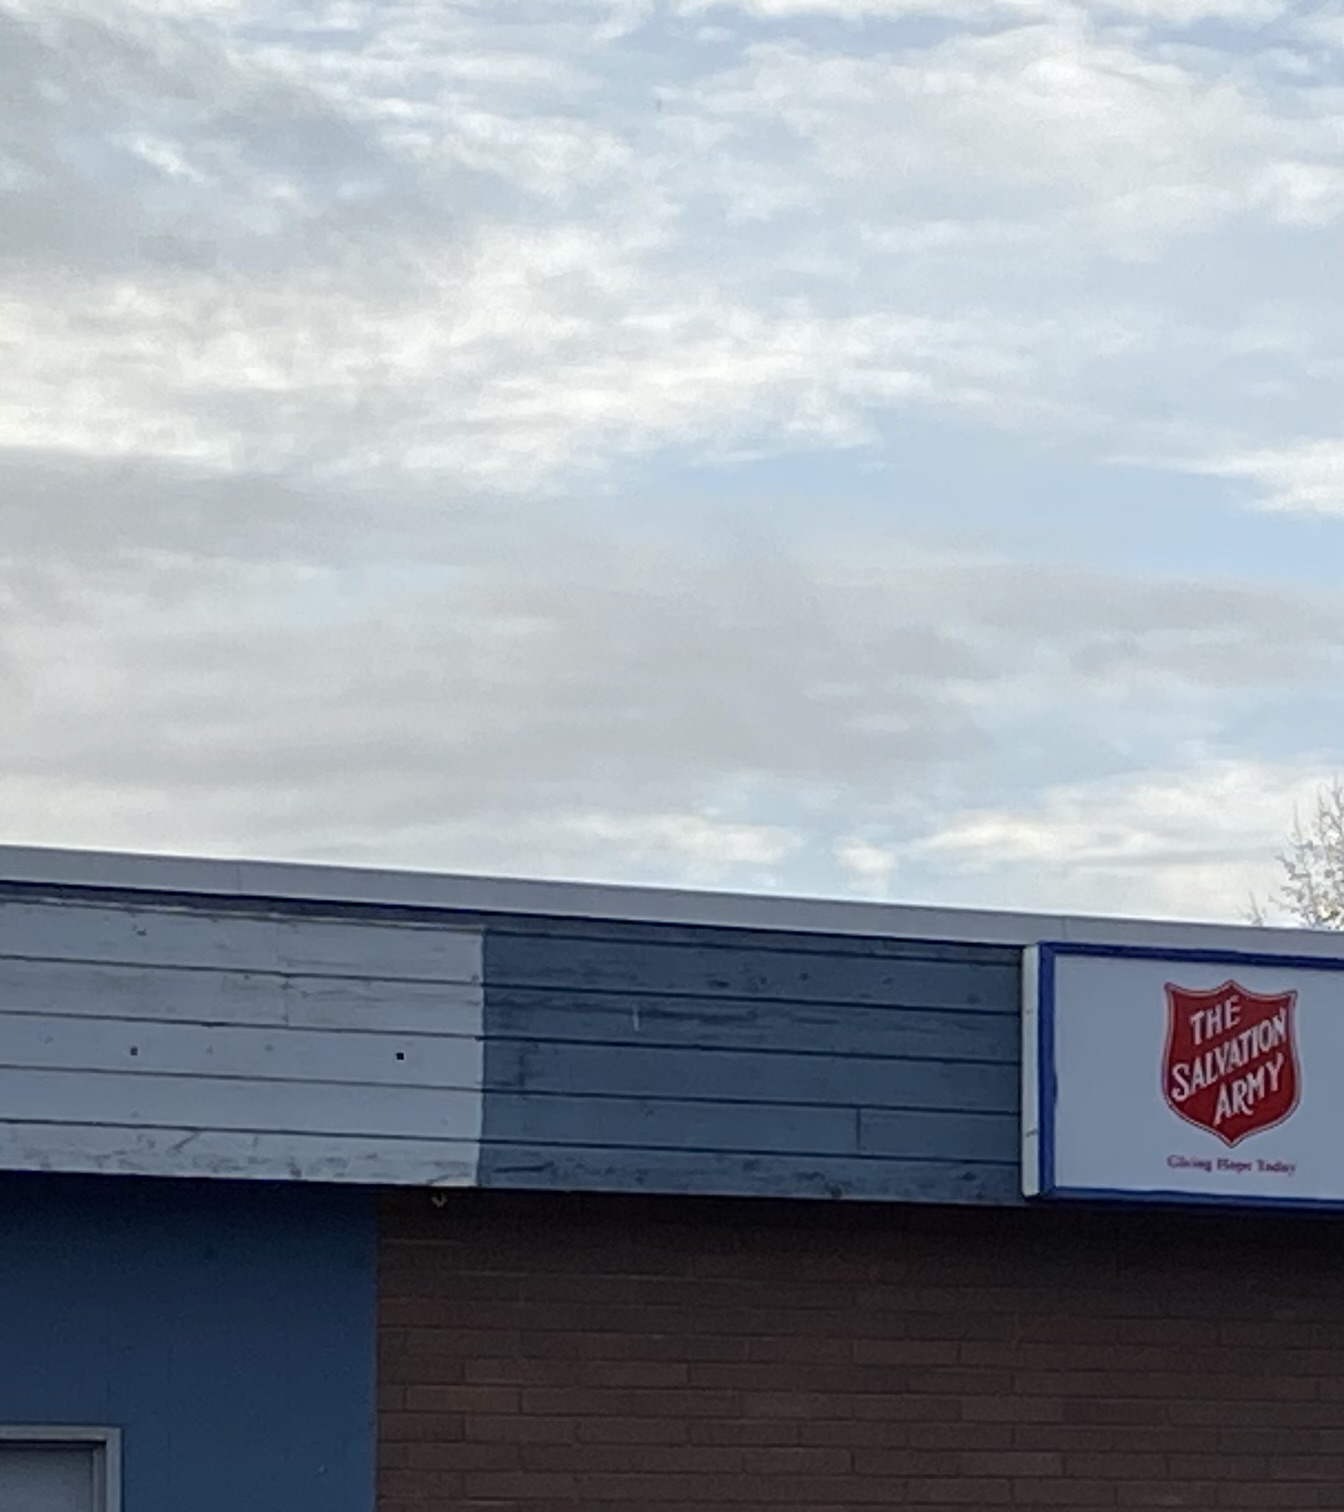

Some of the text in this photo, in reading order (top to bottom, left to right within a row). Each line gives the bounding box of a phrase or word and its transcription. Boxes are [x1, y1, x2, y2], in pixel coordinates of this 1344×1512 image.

[1171, 1006, 1289, 1102] SALVATION
[1190, 994, 1243, 1046] THE
[1213, 1052, 1286, 1127] ARMY
